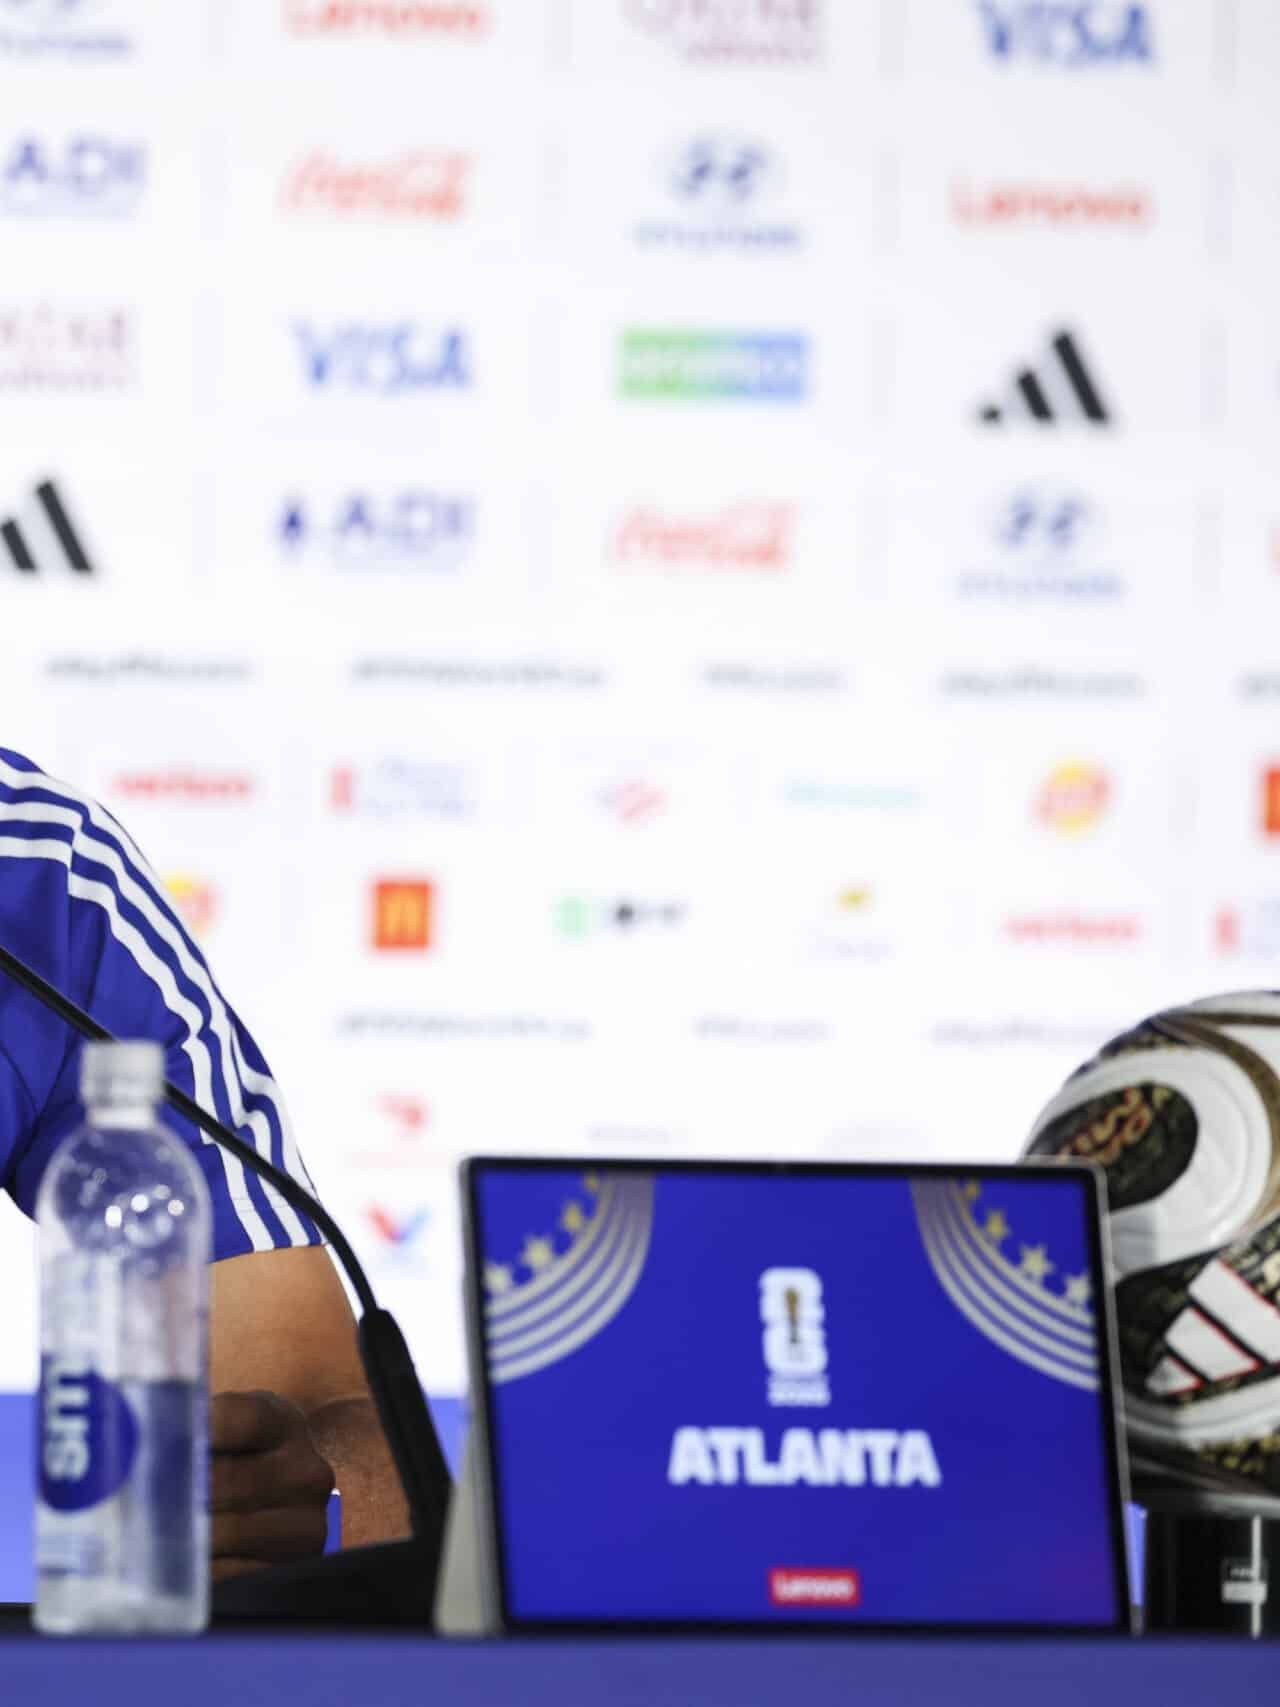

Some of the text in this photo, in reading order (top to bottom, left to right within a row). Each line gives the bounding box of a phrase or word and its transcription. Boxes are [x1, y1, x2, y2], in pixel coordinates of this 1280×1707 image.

[976, 0, 1155, 66] VISA
[294, 320, 473, 395] VISA
[668, 1426, 942, 1487] ATLANTA
